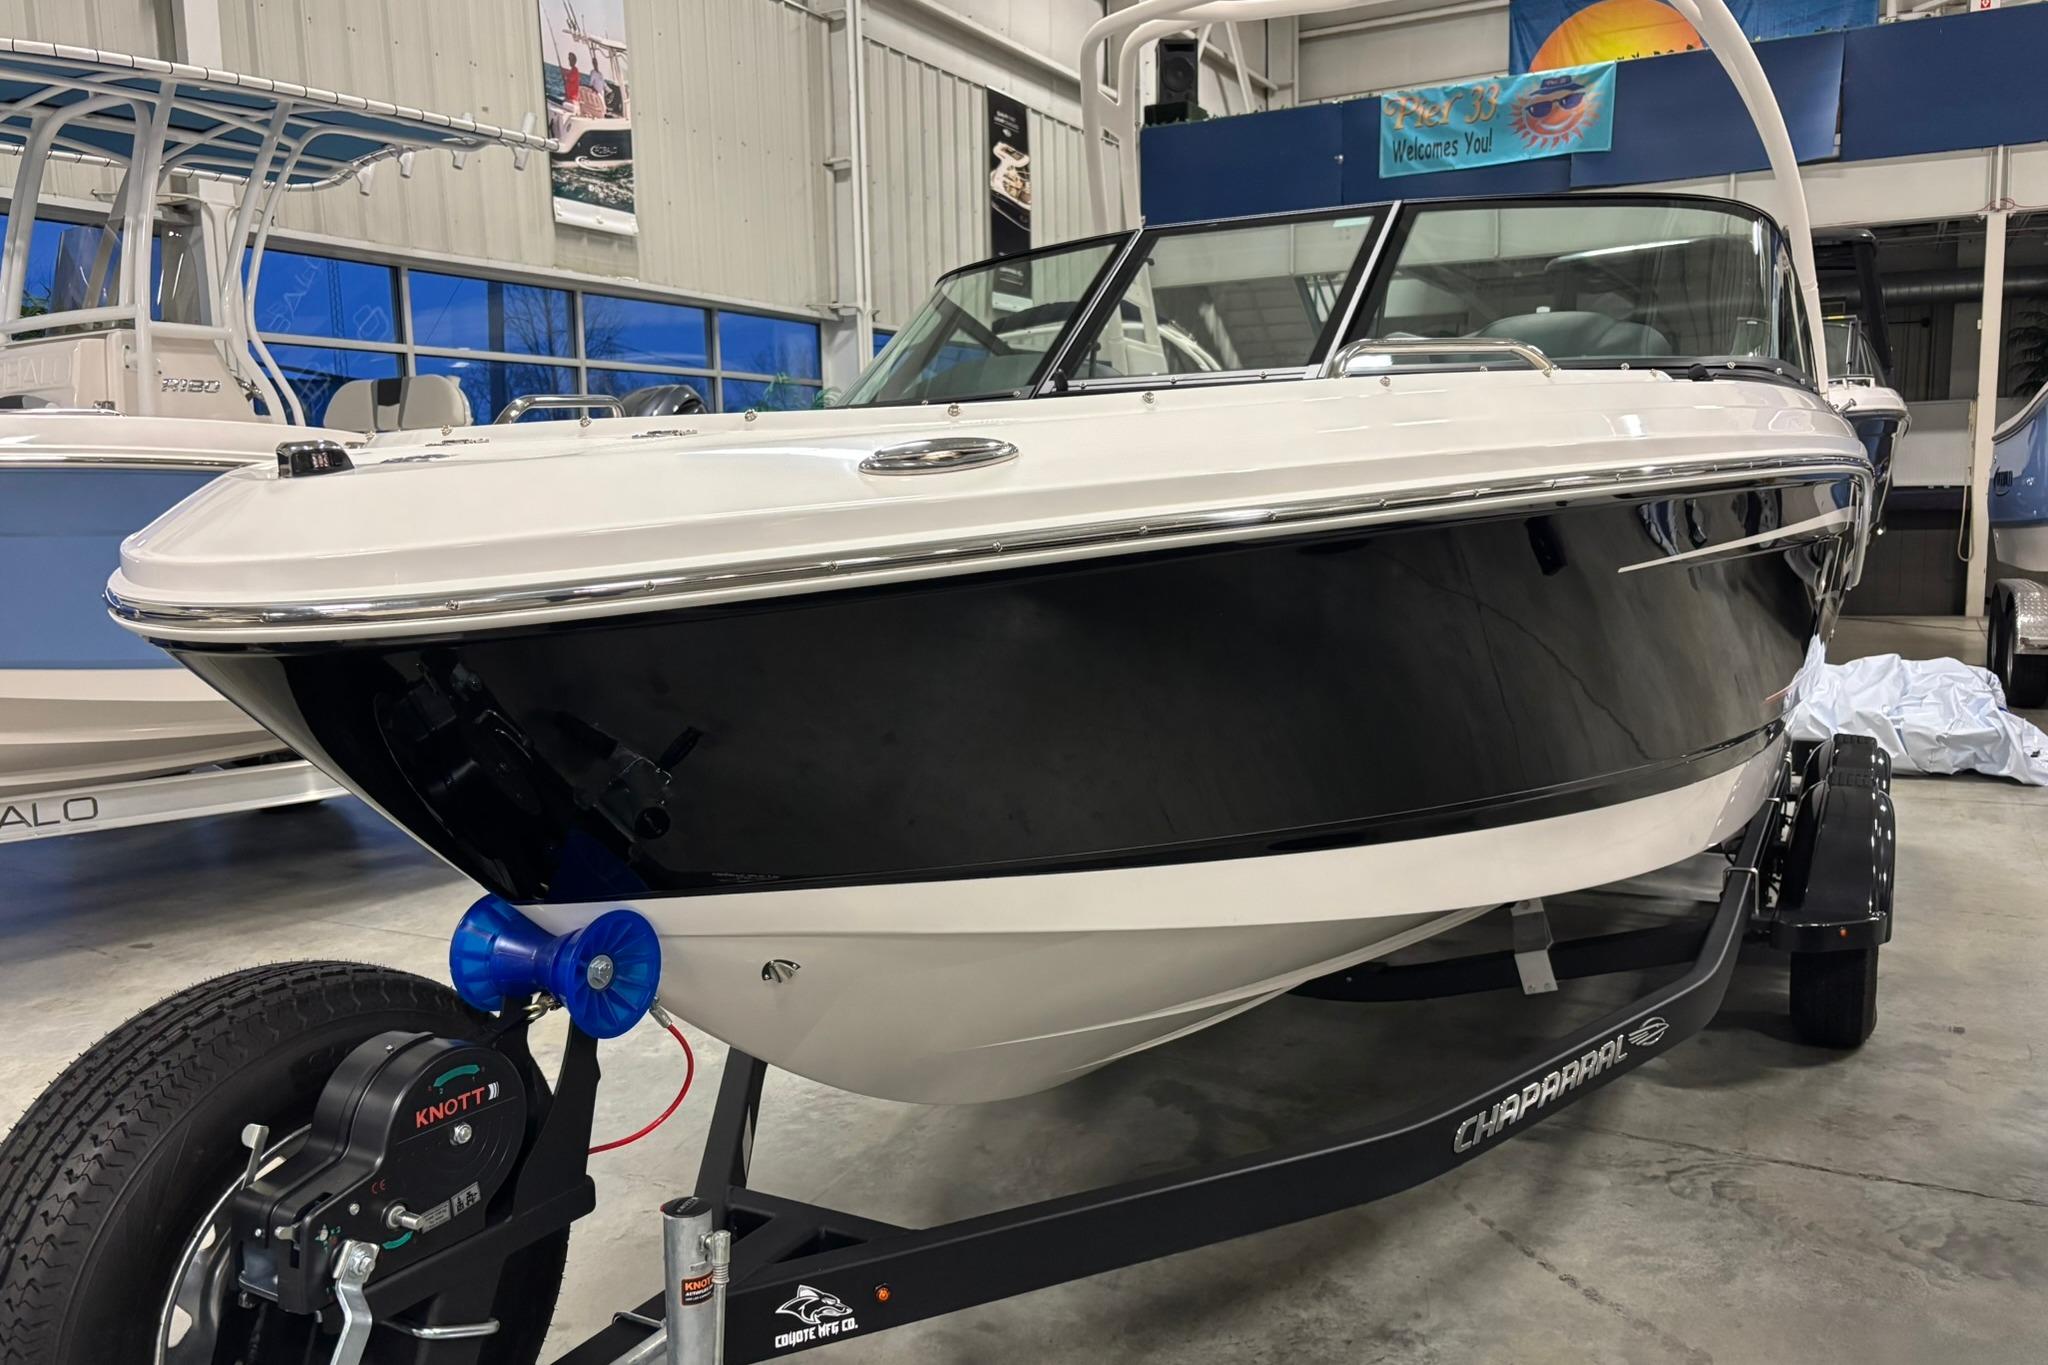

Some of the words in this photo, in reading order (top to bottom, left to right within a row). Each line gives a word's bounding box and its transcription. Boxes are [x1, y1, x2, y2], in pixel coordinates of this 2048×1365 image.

[1383, 92, 1463, 131] Pier
[1464, 84, 1500, 125] 33
[1392, 136, 1458, 163] Welcomes
[1464, 128, 1492, 155] You!
[415, 1086, 485, 1129] KNOTT
[1454, 1034, 1628, 1153] CHAPARRAL
[775, 1327, 816, 1348] COYOTE
[818, 1320, 839, 1338] MFG
[842, 1317, 858, 1332] CO.
